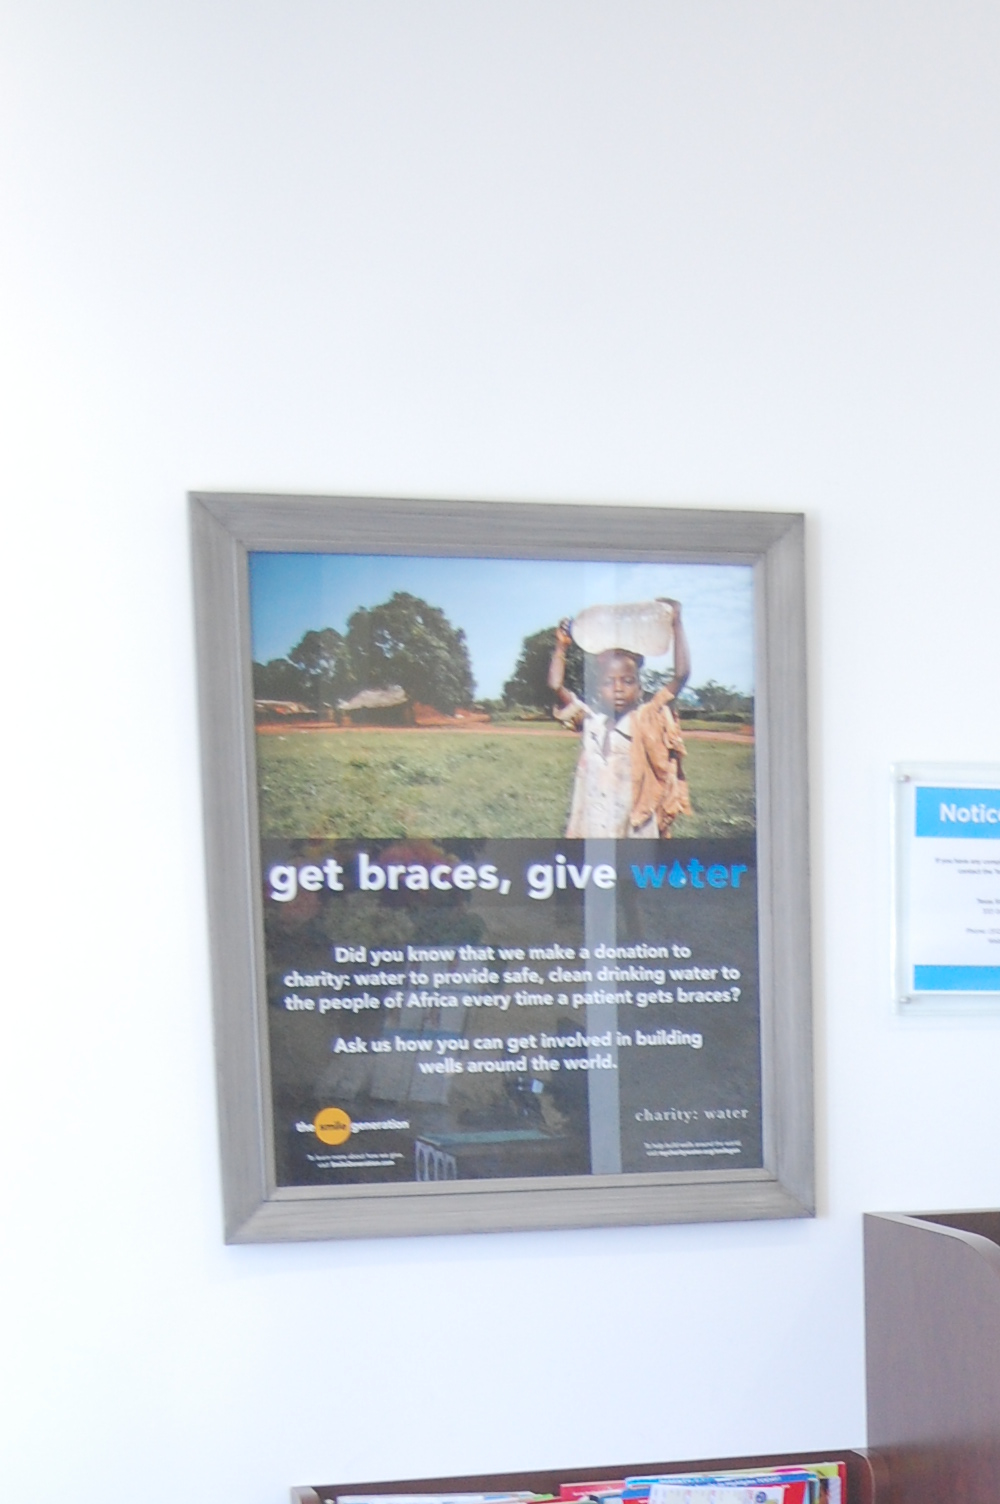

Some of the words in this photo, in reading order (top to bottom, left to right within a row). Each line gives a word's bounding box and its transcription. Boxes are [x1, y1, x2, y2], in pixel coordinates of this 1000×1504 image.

[269, 858, 343, 901] get
[359, 853, 511, 894] braces,
[526, 854, 616, 899] give
[334, 947, 367, 963] Did
[370, 949, 404, 966] you
[407, 946, 454, 962] know
[459, 945, 495, 961] that
[498, 948, 525, 961] we
[530, 945, 576, 961] make
[579, 947, 590, 959] a
[593, 945, 668, 960] donation
[671, 944, 691, 957] to
[284, 970, 351, 991] charity:
[355, 970, 405, 985] water
[409, 971, 430, 984] to
[433, 969, 499, 988] provide
[502, 969, 544, 985] safe,
[549, 968, 593, 983] clean
[596, 966, 666, 984] drinking
[670, 968, 718, 981] water
[720, 967, 740, 980] to
[285, 995, 315, 1011] the
[318, 995, 380, 1013] people
[383, 992, 404, 1008] of
[407, 991, 459, 1008] Africa
[462, 993, 511, 1011] every
[515, 990, 553, 1006] time
[557, 993, 568, 1005] a
[572, 989, 633, 1008] patient
[635, 990, 674, 1005] gets
[677, 986, 740, 1003] braces?
[334, 1038, 368, 1054] Ask
[371, 1040, 391, 1053] us
[396, 1036, 433, 1052] how
[437, 1038, 469, 1055] you
[473, 1038, 503, 1051] can
[507, 1036, 537, 1054] get
[540, 1033, 613, 1049] involved
[616, 1033, 632, 1047] in
[635, 1031, 703, 1049] building
[419, 1057, 463, 1074] wells
[467, 1056, 528, 1073] around
[531, 1055, 560, 1071] the
[564, 1054, 617, 1071] world.
[295, 1121, 315, 1133] the
[351, 1119, 410, 1133] generation
[634, 1108, 698, 1124] charity:
[704, 1109, 749, 1119] water
